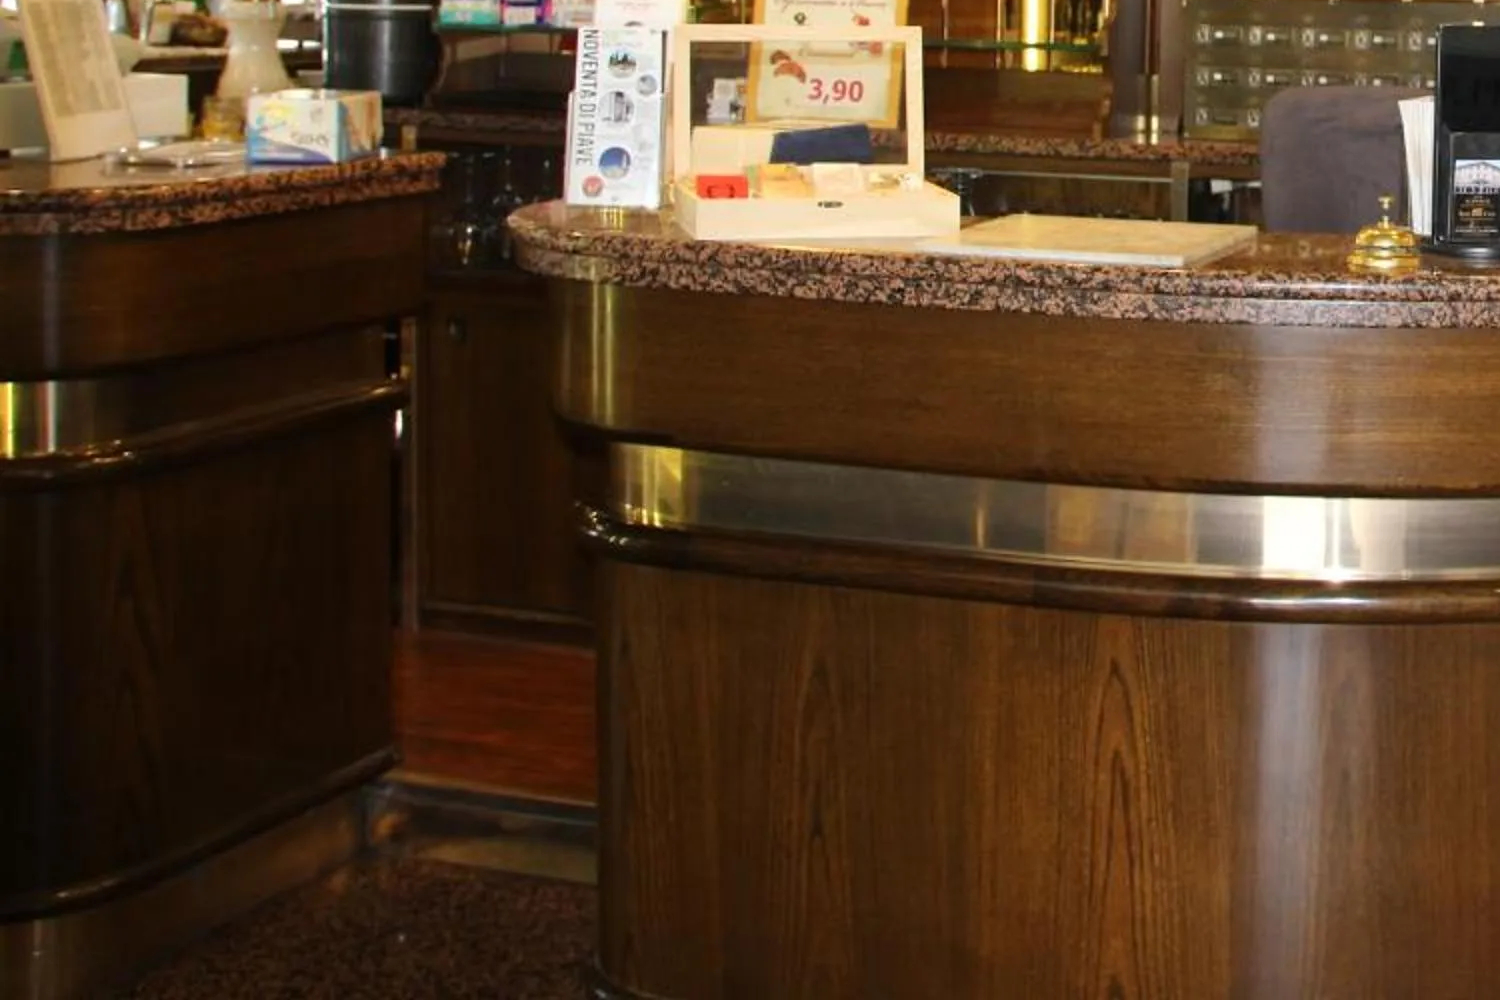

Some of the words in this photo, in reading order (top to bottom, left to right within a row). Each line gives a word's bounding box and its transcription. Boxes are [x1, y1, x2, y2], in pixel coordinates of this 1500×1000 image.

[580, 28, 600, 99] NOVENTA
[807, 78, 864, 104] 3,90
[575, 124, 596, 166] PIAVE
